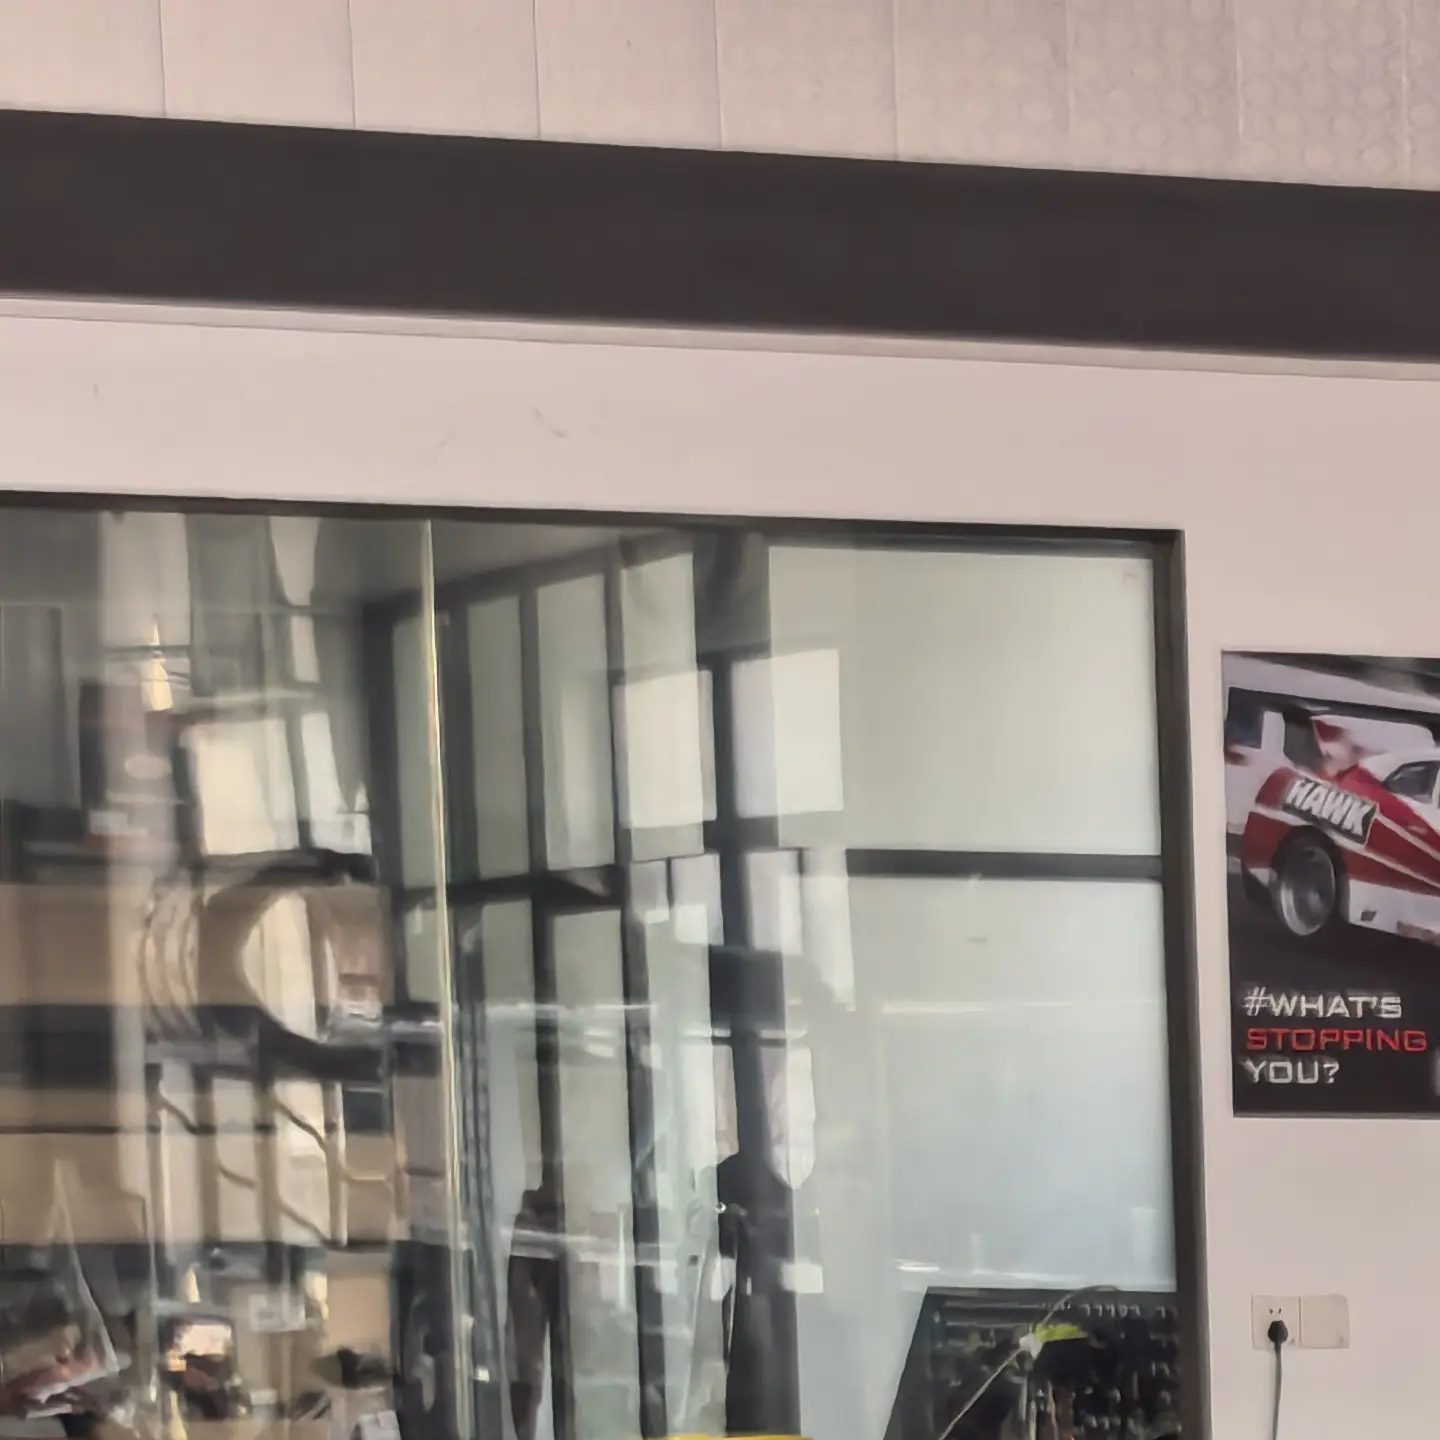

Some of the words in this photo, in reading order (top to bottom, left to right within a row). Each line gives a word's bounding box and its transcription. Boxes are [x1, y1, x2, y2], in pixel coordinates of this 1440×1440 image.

[1284, 778, 1371, 836] HAWK
[1243, 986, 1402, 1019] #WHAT'S
[1246, 1027, 1428, 1052] STOPPING
[1241, 1059, 1340, 1084] YOU?
